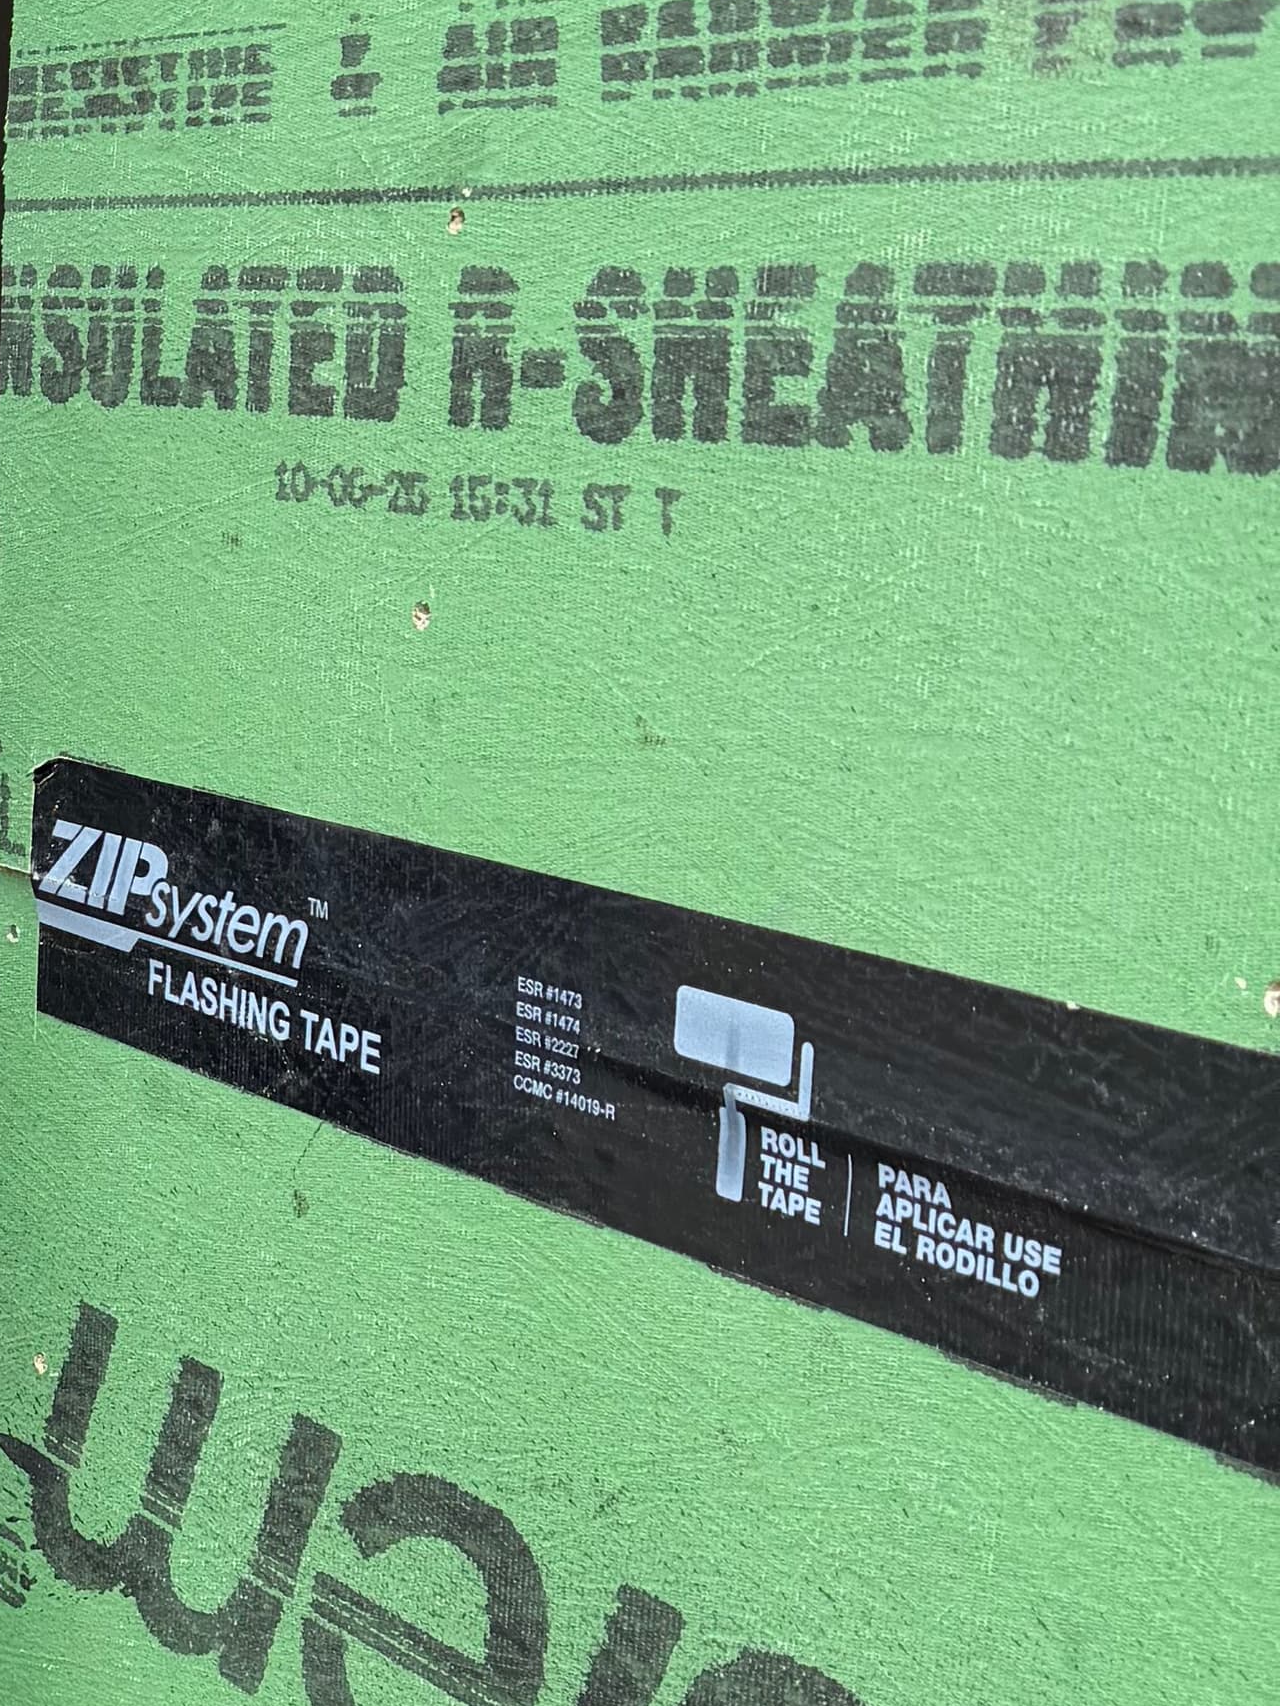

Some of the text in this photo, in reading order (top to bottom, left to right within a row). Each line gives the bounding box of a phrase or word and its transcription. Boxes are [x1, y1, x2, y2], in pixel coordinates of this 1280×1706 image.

[450, 474, 560, 527] 15:31
[38, 819, 169, 916] ZIP
[144, 877, 310, 970] system
[517, 976, 582, 1009] ESR #1473
[147, 958, 382, 1075] FLASHING TAPE
[516, 1001, 581, 1035] ESR #1474
[515, 1026, 580, 1059] ESR #2227
[515, 1050, 581, 1084] ESR #3373
[513, 1074, 616, 1121] CCMC #14019-R
[760, 1125, 826, 1170] ROLL
[760, 1152, 810, 1193] THE
[877, 1162, 953, 1210] PARA
[758, 1181, 822, 1226] TAPE
[875, 1193, 1062, 1277] APLICAR USE
[874, 1220, 1040, 1299] EL RODILLO
